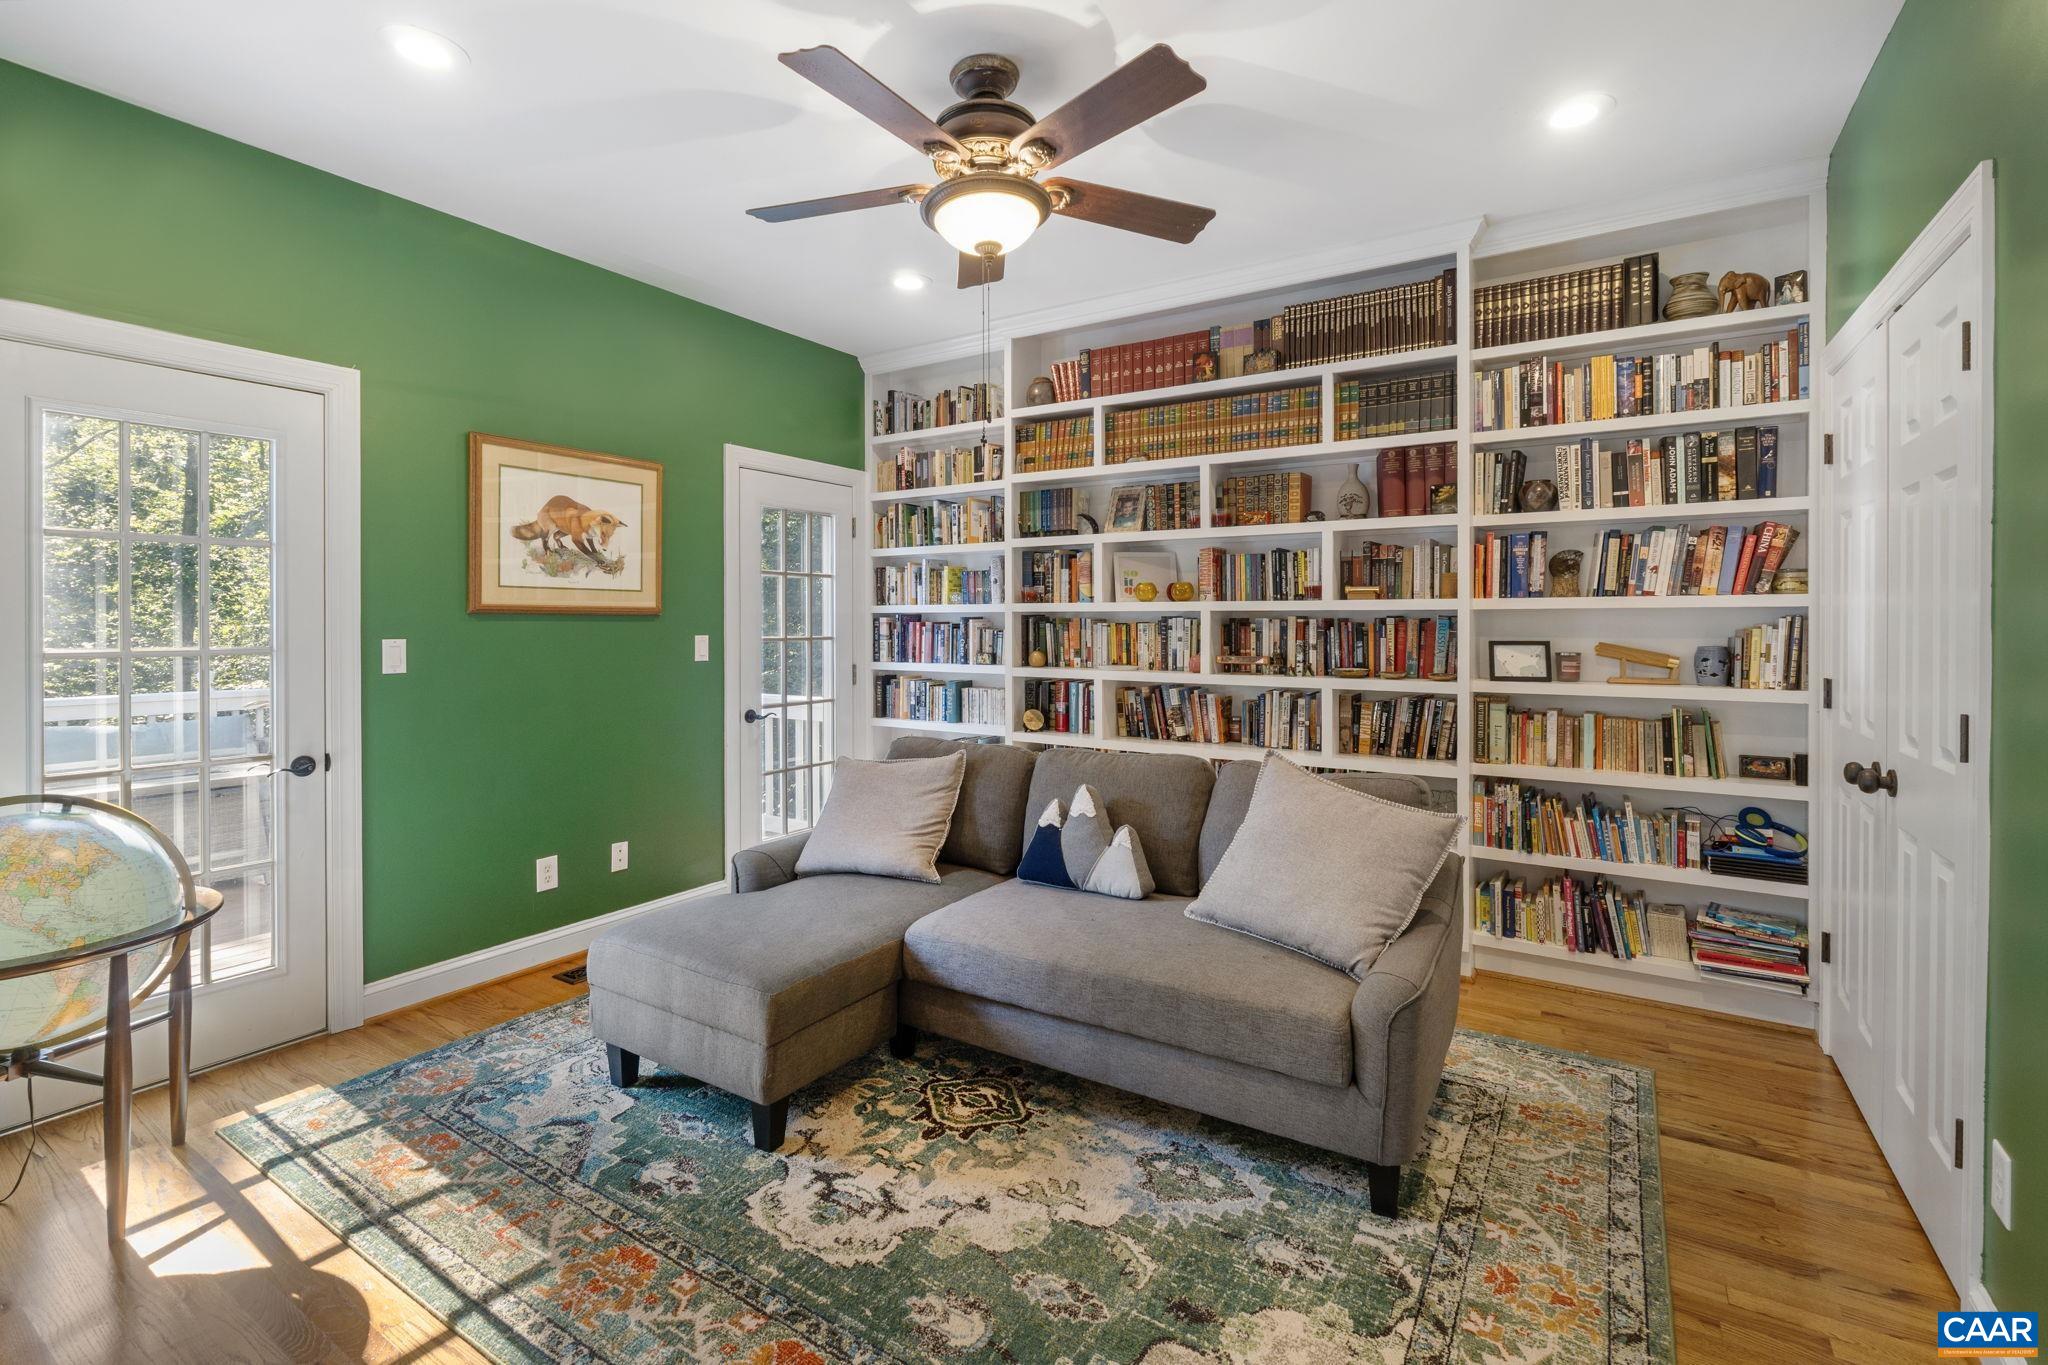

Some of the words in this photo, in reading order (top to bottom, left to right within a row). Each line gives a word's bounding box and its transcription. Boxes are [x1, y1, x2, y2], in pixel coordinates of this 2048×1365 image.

[1668, 446, 1676, 466] JOHN
[1669, 467, 1677, 494] ADAMS
[1711, 531, 1723, 551] 1421
[1757, 527, 1774, 553] CHINA
[1436, 622, 1449, 655] RUSSIA
[1359, 709, 1372, 739] AFRICA
